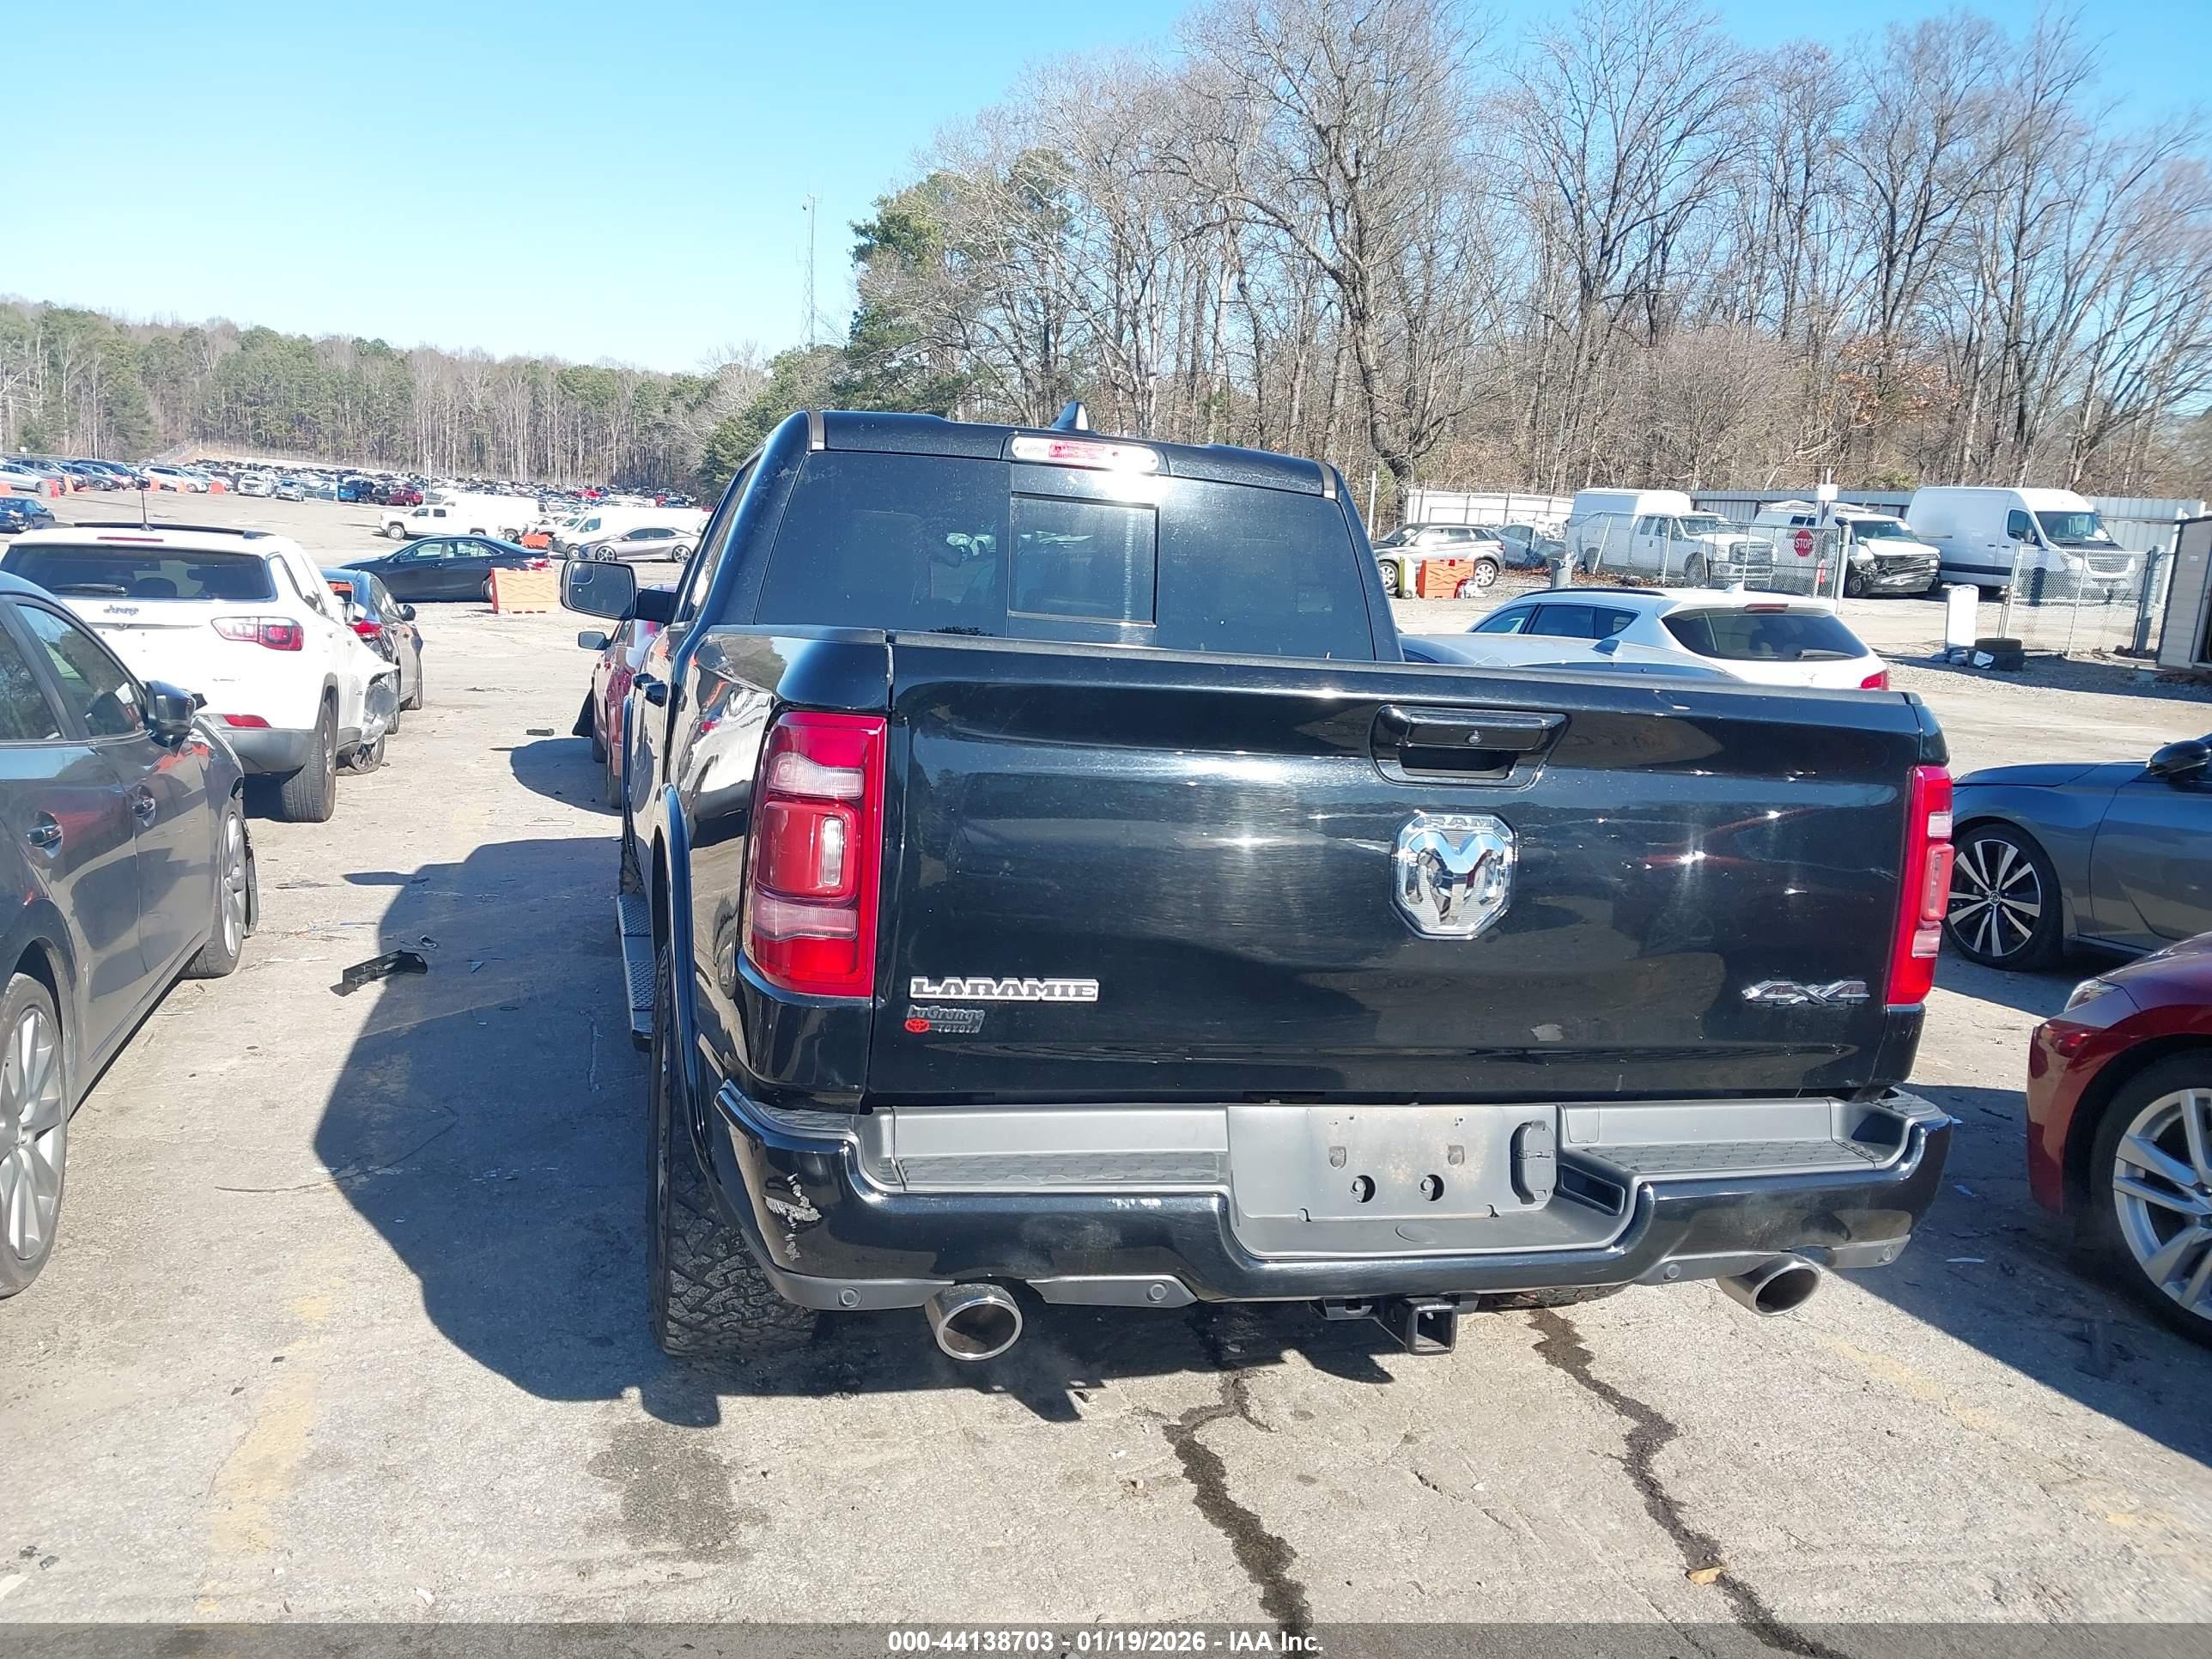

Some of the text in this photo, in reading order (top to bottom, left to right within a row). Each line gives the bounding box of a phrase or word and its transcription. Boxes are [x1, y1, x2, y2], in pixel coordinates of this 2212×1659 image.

[1796, 538, 1813, 550] STOP
[1425, 817, 1493, 827] RAM
[910, 977, 1099, 1002] LARAMIE
[908, 1005, 985, 1024] LaGrange
[939, 1024, 980, 1033] TOYOTA
